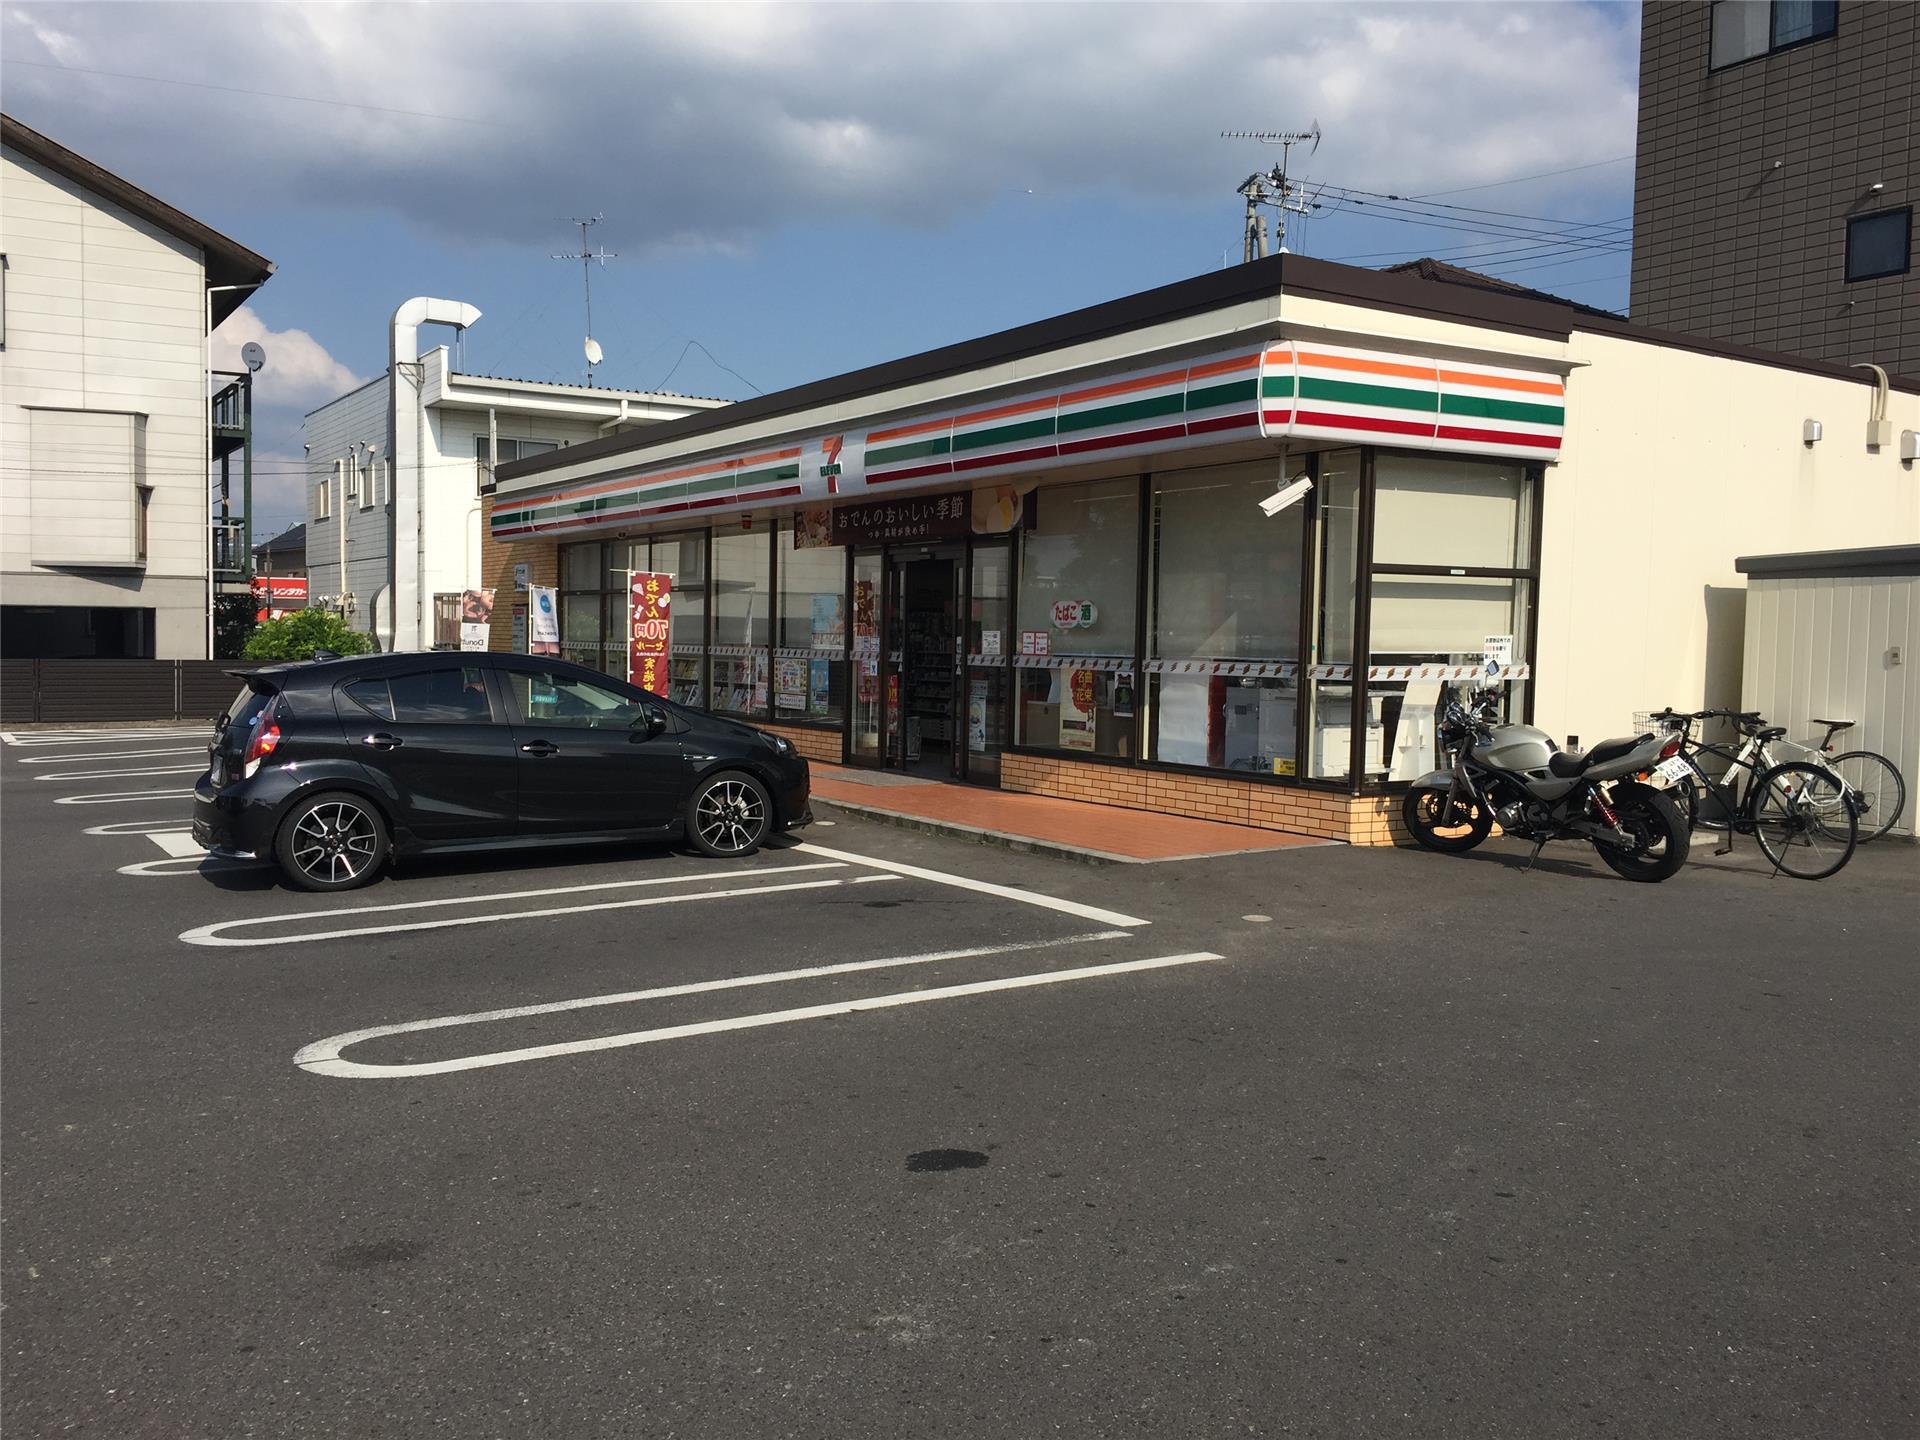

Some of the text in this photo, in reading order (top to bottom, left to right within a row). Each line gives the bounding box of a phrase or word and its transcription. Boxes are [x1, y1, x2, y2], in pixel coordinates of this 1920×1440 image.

[821, 432, 844, 494] 7
[839, 495, 964, 529] おでんのおいしい季節
[1055, 604, 1077, 621] たばこ
[1080, 604, 1091, 621] 酒
